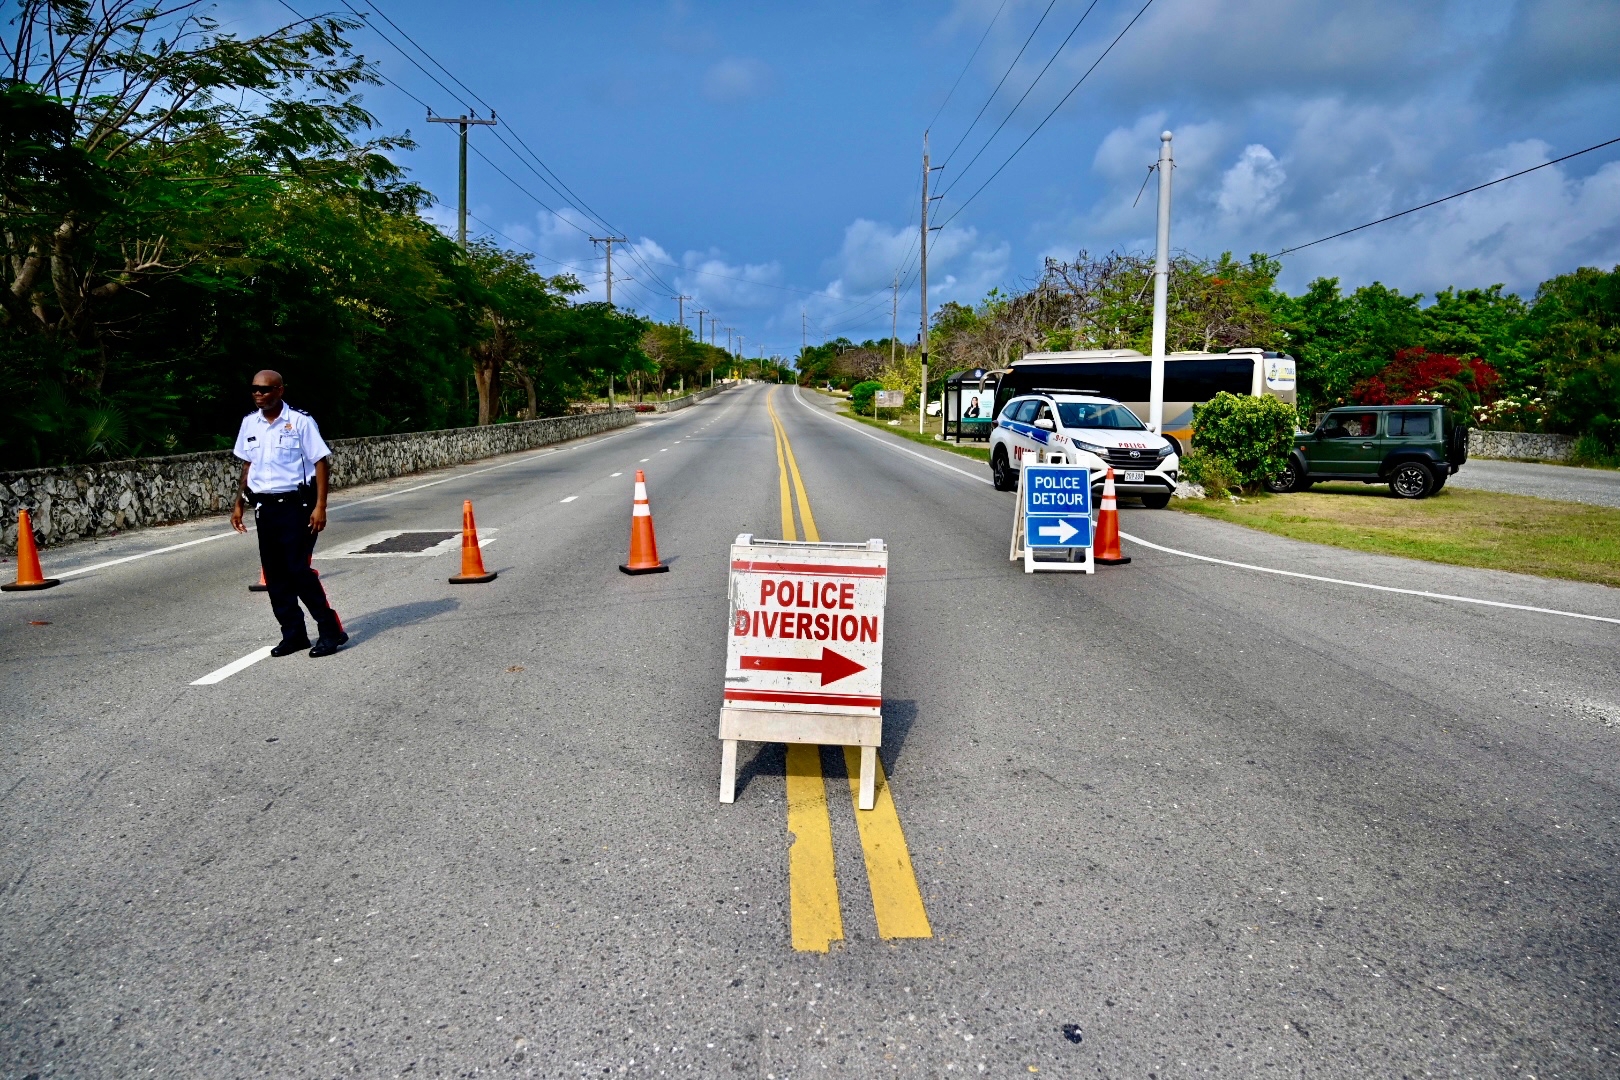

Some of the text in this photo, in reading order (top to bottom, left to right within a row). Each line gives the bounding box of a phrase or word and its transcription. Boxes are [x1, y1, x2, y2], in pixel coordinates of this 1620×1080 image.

[1035, 476, 1080, 490] POLICE
[1032, 492, 1084, 506] DETOUR
[760, 579, 855, 610] POLICE
[733, 610, 878, 643] DIVERSION
